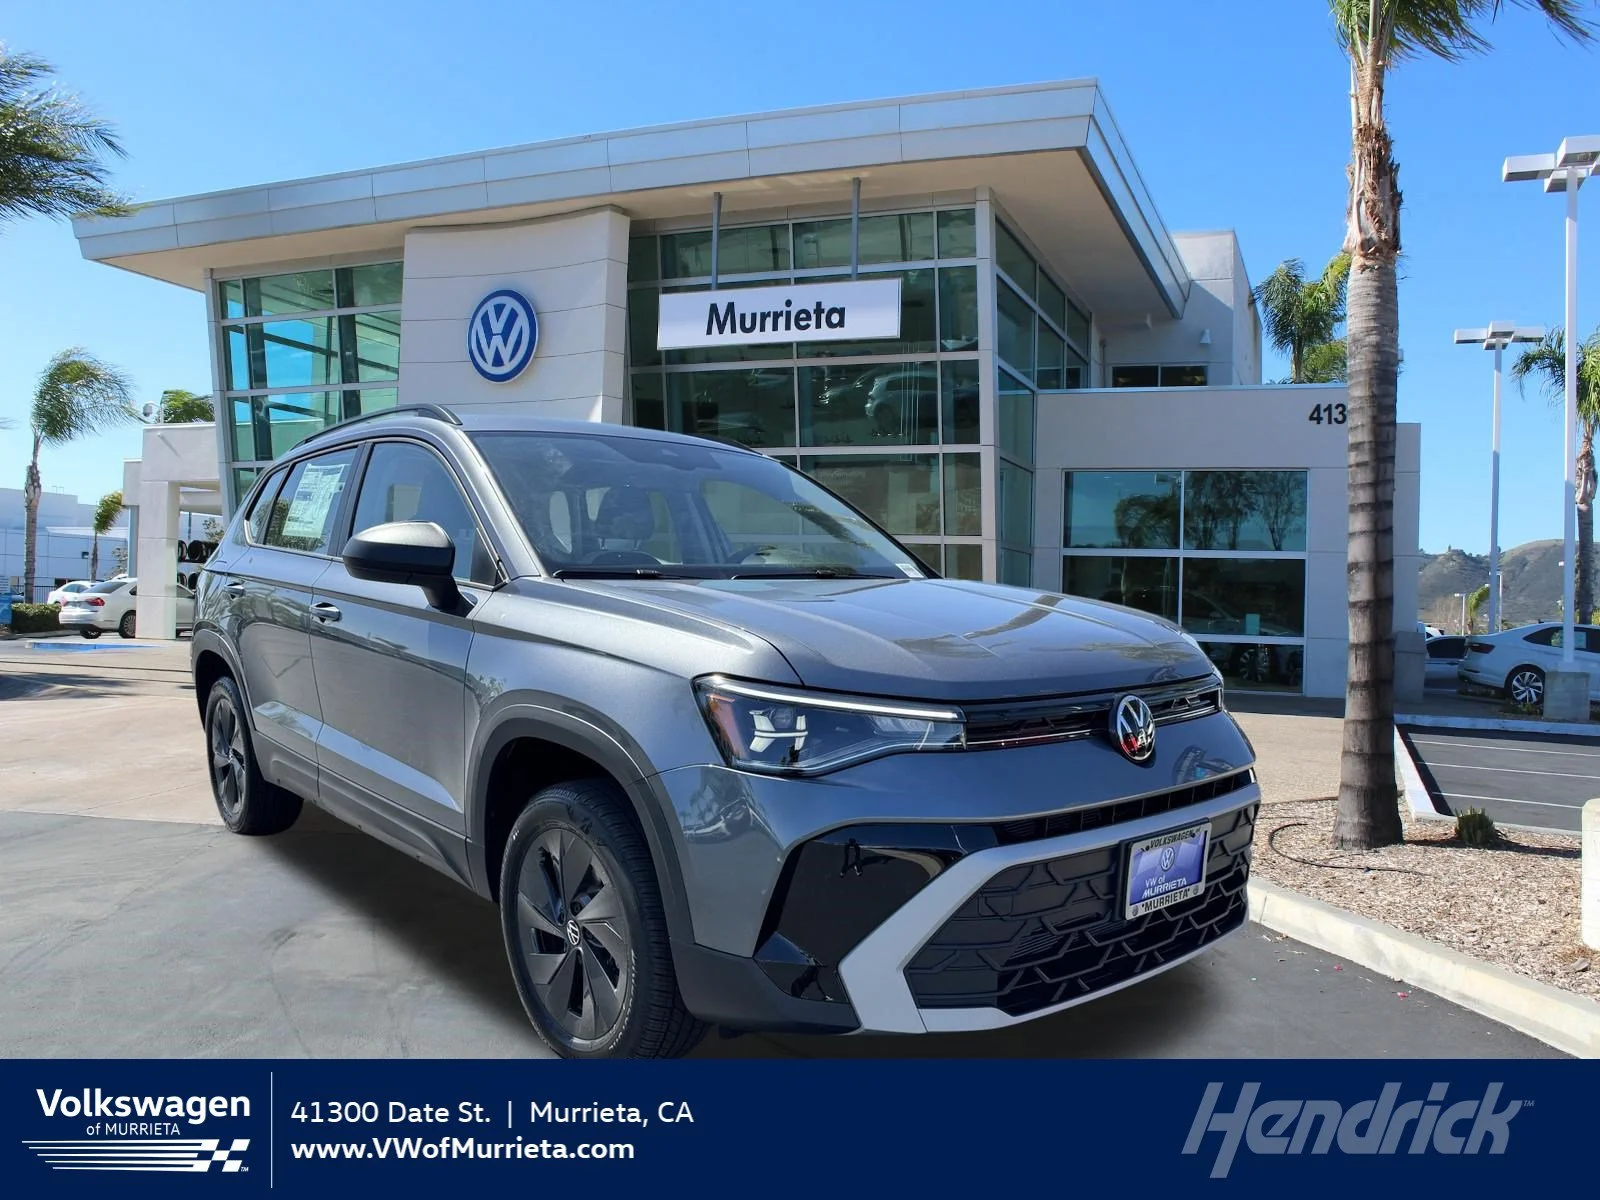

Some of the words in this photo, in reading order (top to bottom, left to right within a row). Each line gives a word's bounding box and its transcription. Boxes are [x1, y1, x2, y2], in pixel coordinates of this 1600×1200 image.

[706, 299, 846, 336] Murrieta
[1150, 830, 1194, 847] VOLKSWAGEN
[1142, 877, 1187, 899] MURRIETA
[1145, 877, 1157, 888] VW
[1158, 875, 1166, 884] of
